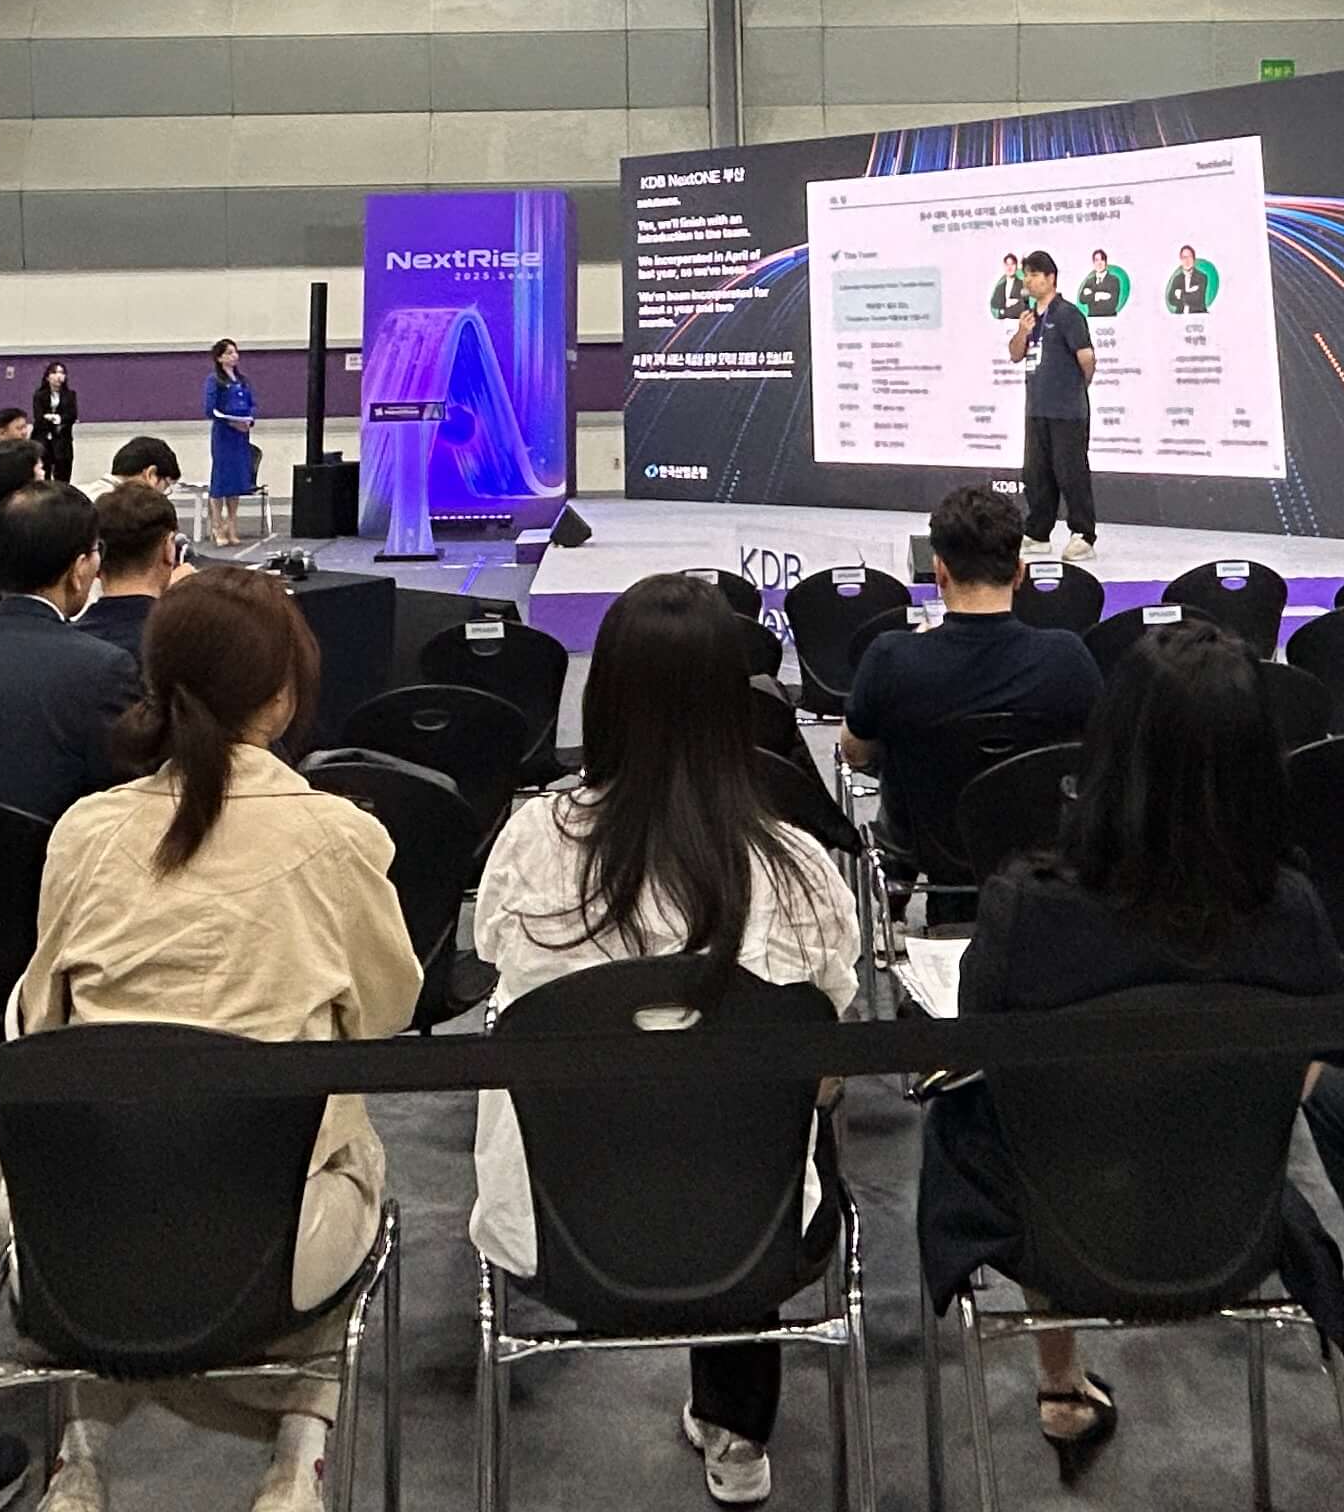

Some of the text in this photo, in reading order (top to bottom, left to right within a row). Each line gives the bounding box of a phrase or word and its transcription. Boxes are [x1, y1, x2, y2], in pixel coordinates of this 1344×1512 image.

[640, 176, 666, 190] KDB
[667, 169, 721, 187] NextONE
[680, 216, 706, 229] finish
[707, 214, 728, 226] with
[729, 215, 743, 225] an
[386, 249, 541, 270] NextRise
[714, 251, 723, 262] in
[725, 249, 749, 264] April
[750, 248, 761, 260] of
[992, 480, 1017, 494] KDB
[740, 545, 805, 590] KDB
